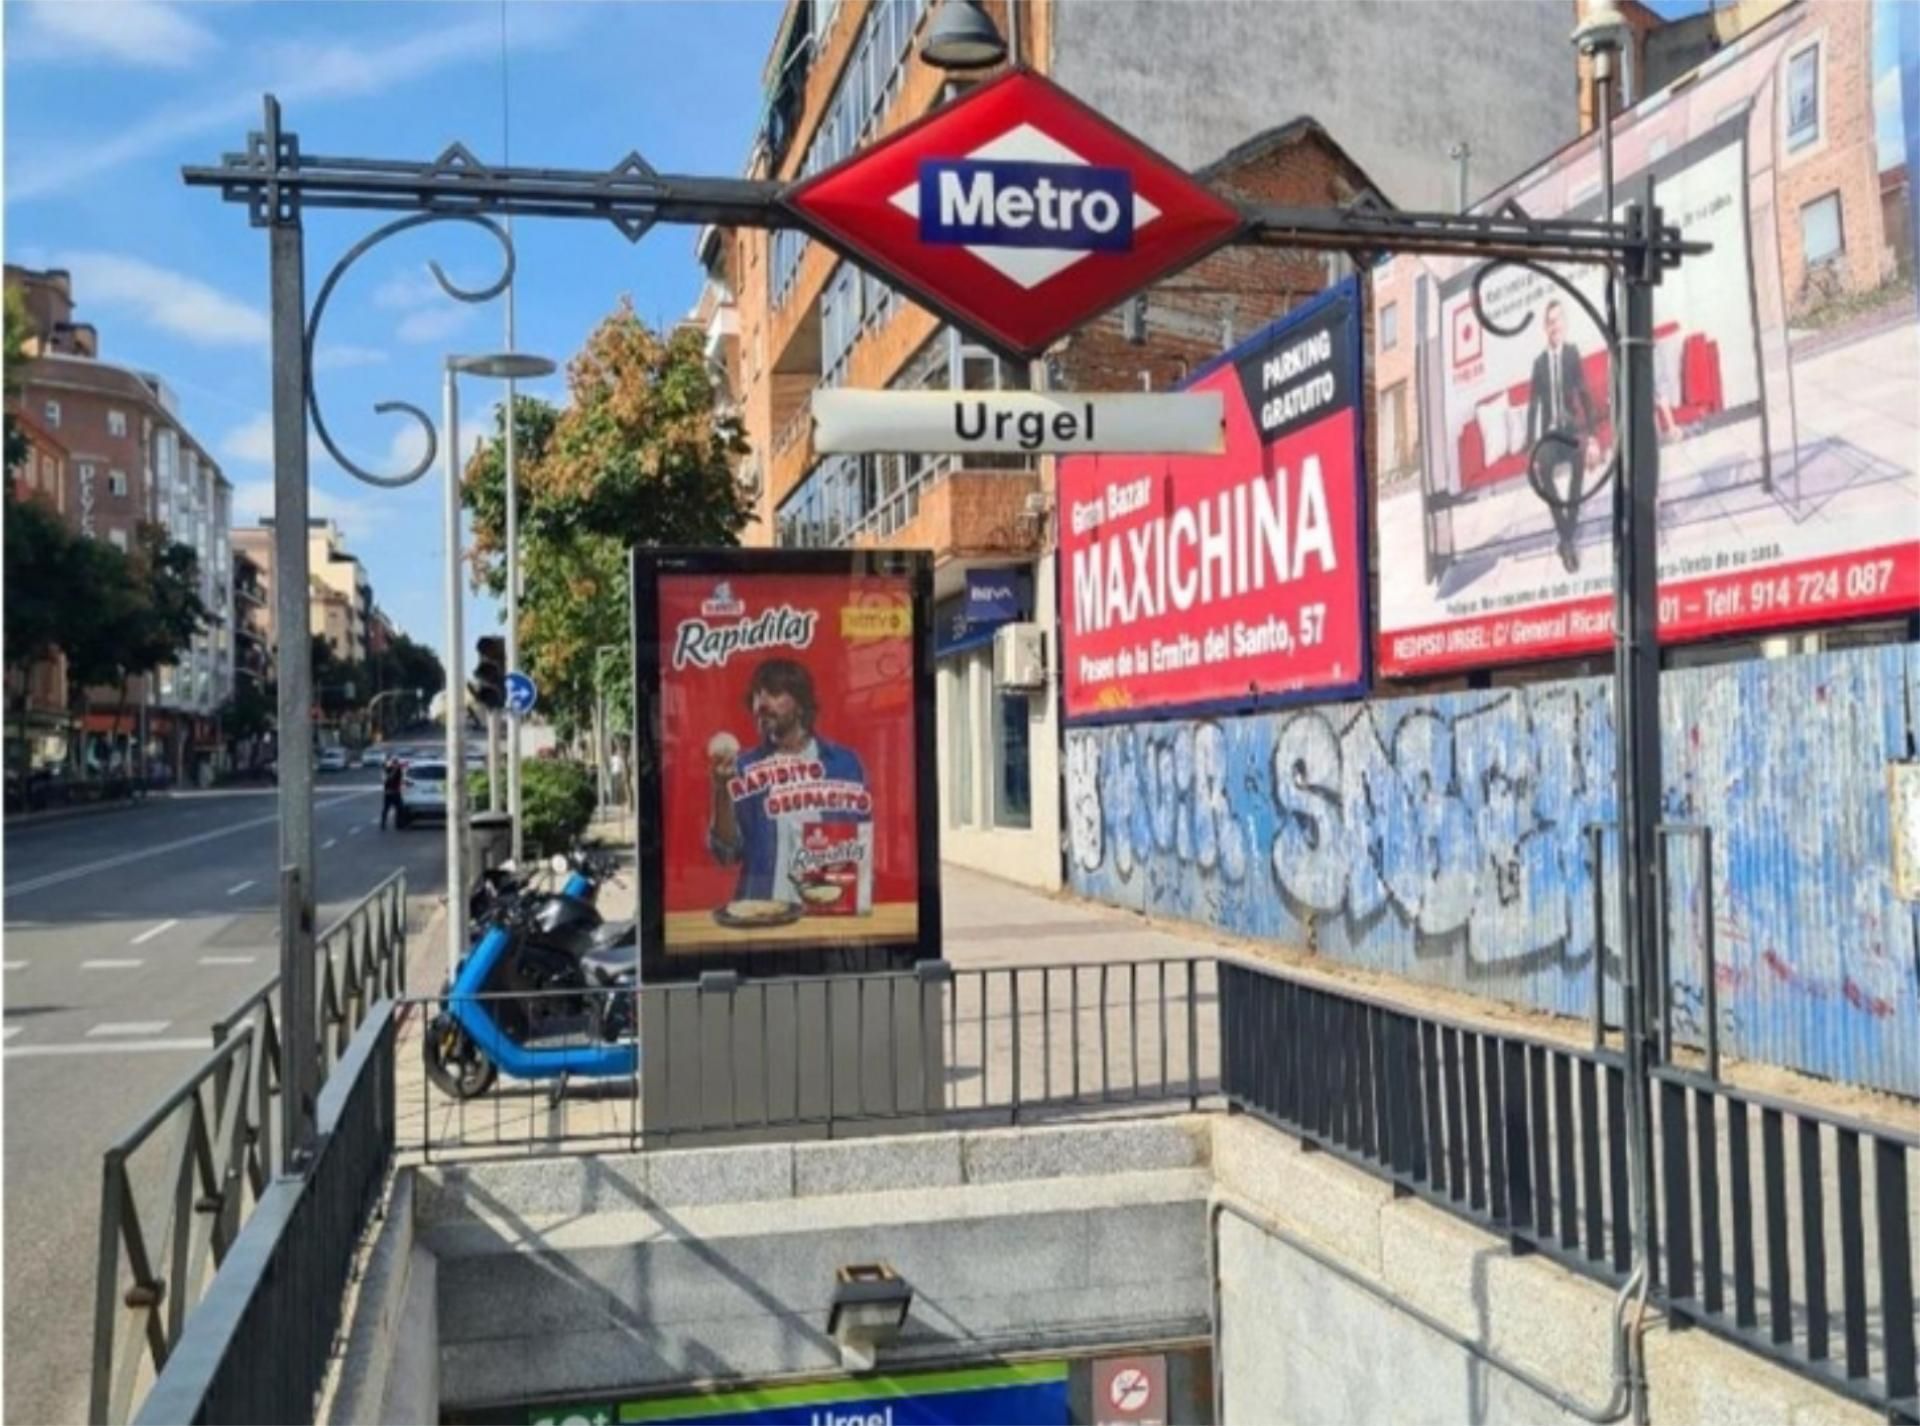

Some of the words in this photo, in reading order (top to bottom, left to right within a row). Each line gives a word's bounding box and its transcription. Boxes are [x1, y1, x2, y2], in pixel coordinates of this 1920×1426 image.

[938, 170, 1120, 233] Metro
[1262, 328, 1332, 392] PARKING
[954, 401, 1094, 449] Urgel
[1262, 370, 1335, 431] GRATUITO
[1071, 496, 1105, 537] Gran
[1106, 475, 1151, 522] Bazar
[1072, 454, 1337, 635] MAXICHINA
[1511, 613, 1567, 645] General
[1703, 582, 1746, 618] Telf.
[1750, 576, 1791, 614] 914
[1798, 568, 1839, 605] 724
[1846, 558, 1894, 598] 087
[673, 605, 818, 670] Rapiditas
[1117, 647, 1134, 679] de
[1135, 644, 1150, 675] la
[1151, 633, 1200, 674] Ermita
[1203, 624, 1230, 665] del
[1232, 613, 1296, 659] Santo,
[1299, 602, 1326, 647] 57
[729, 761, 823, 799] RAPIDITO
[767, 789, 868, 815] DESPACITO
